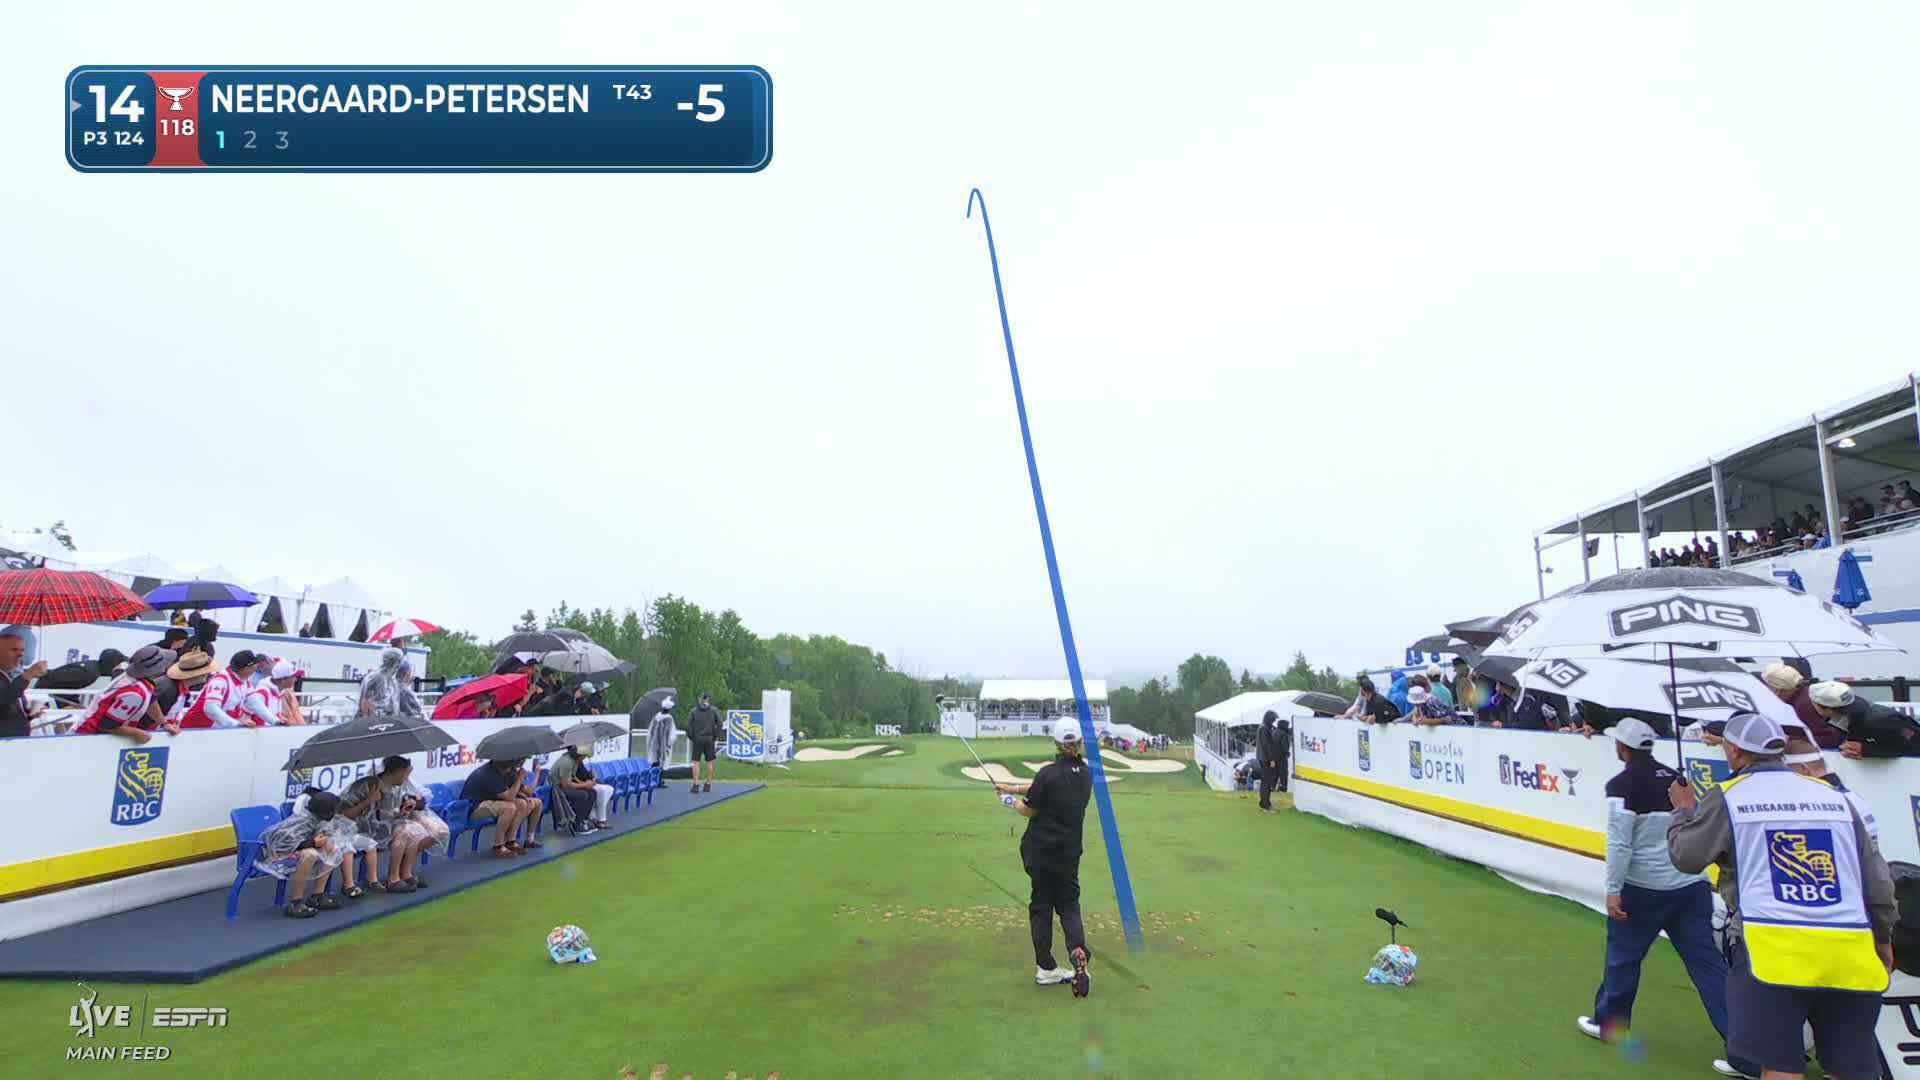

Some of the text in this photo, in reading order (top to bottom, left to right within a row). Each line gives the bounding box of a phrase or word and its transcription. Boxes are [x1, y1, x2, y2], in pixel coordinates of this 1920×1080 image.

[1620, 600, 1750, 631] PING
[1675, 684, 1756, 713] PING
[874, 723, 903, 737] RBC
[439, 744, 475, 768] FedEx
[731, 743, 763, 756] RBC
[1424, 759, 1465, 785] OPEN
[1512, 761, 1561, 793] FedEx
[116, 800, 159, 822] RBC
[1780, 884, 1838, 902] RBC
